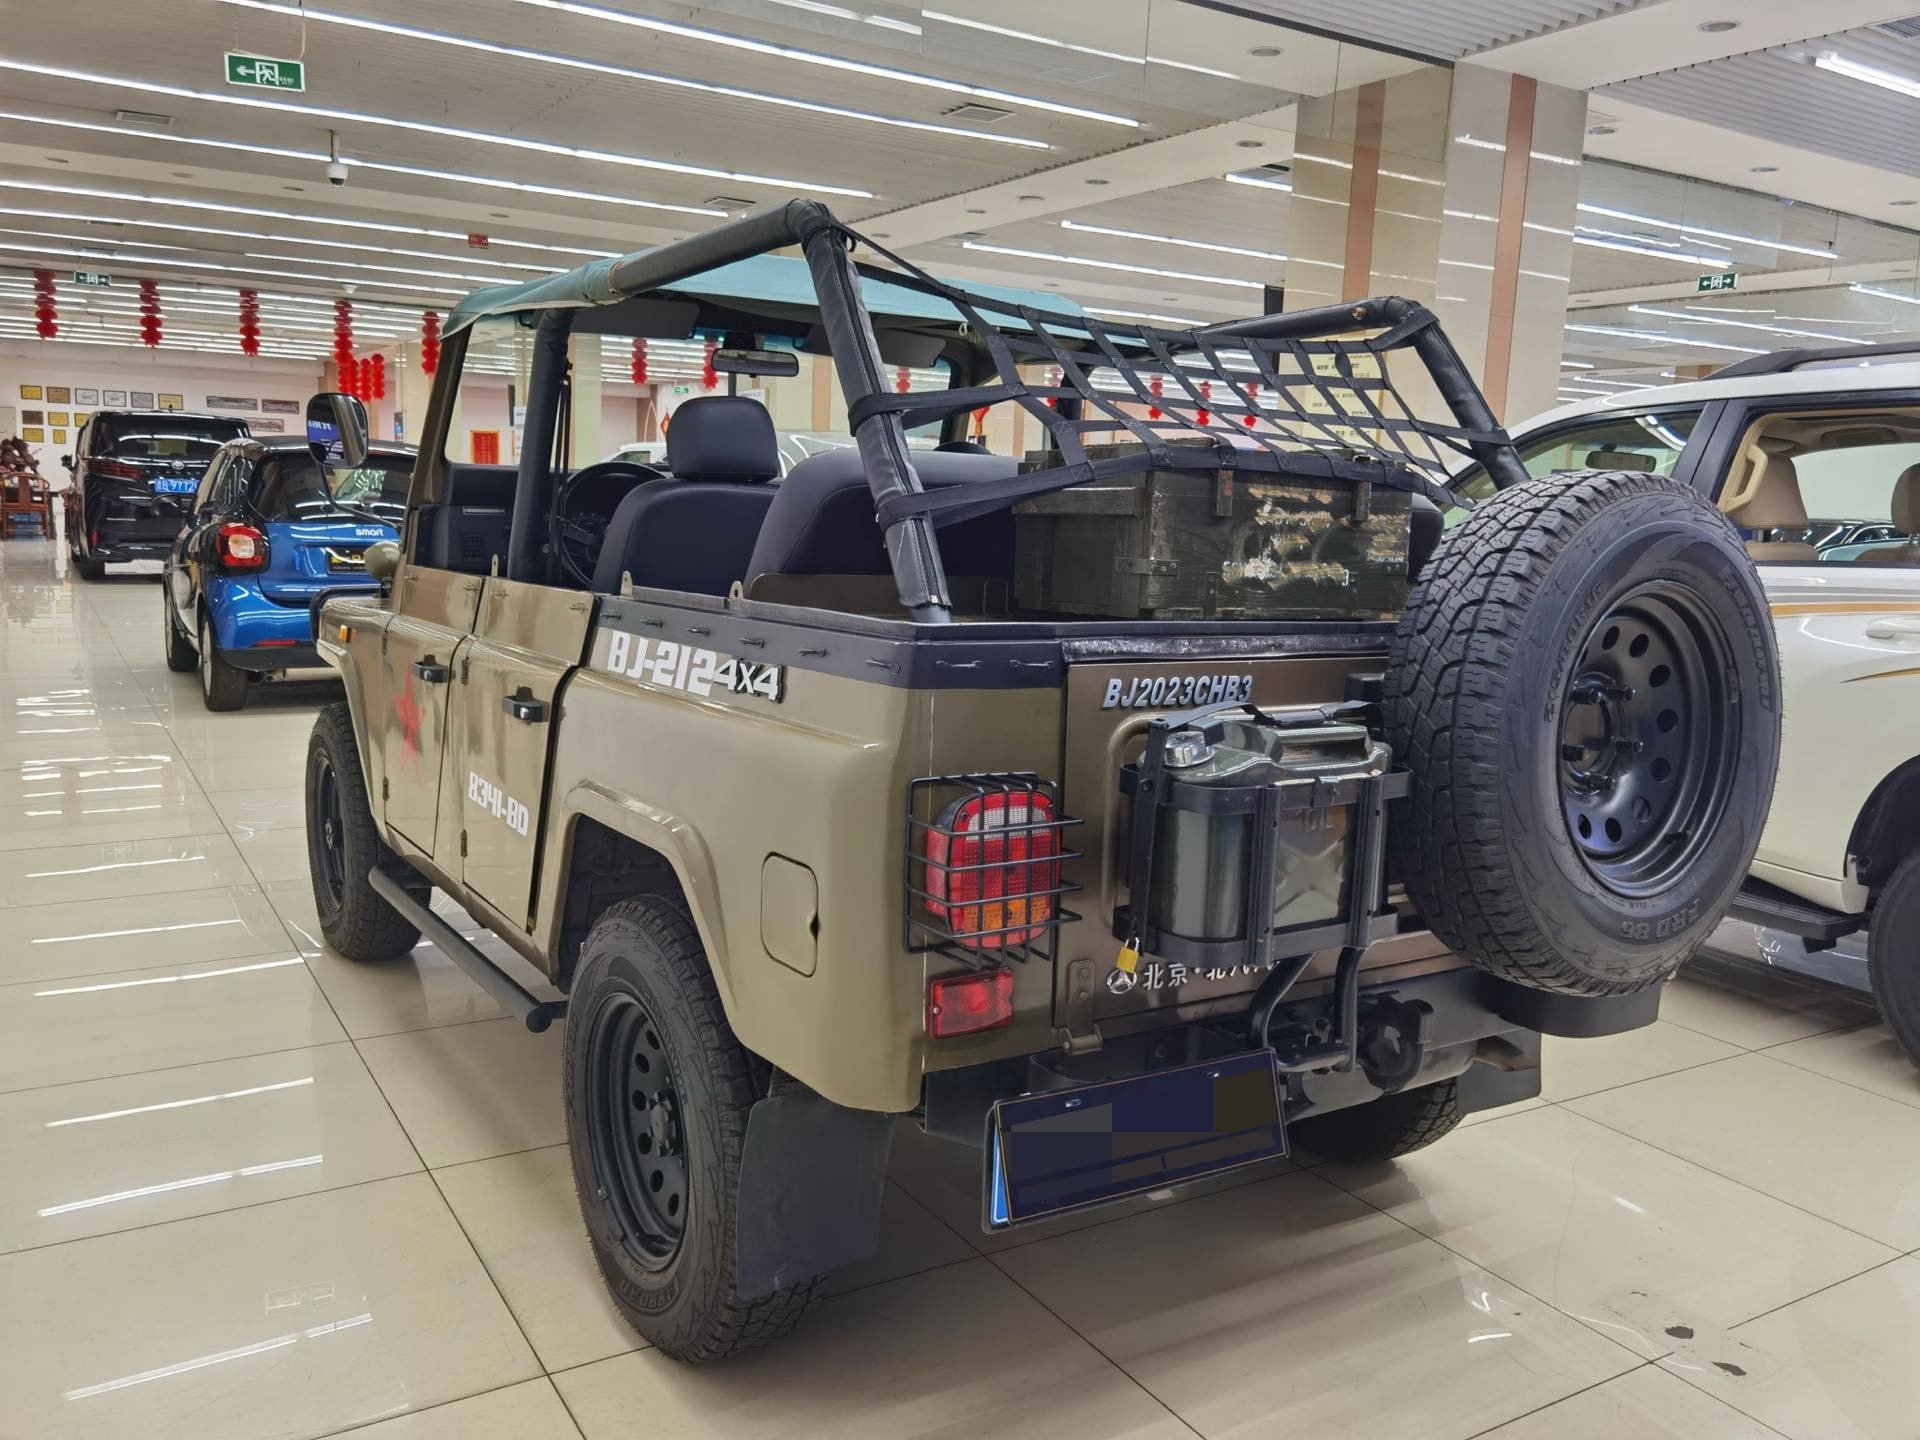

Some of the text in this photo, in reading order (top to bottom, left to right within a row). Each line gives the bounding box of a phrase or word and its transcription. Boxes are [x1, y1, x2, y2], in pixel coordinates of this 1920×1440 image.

[355, 528, 384, 537] smart
[607, 629, 718, 697] BJ-212
[1102, 674, 1254, 709] BJ2023CHB3
